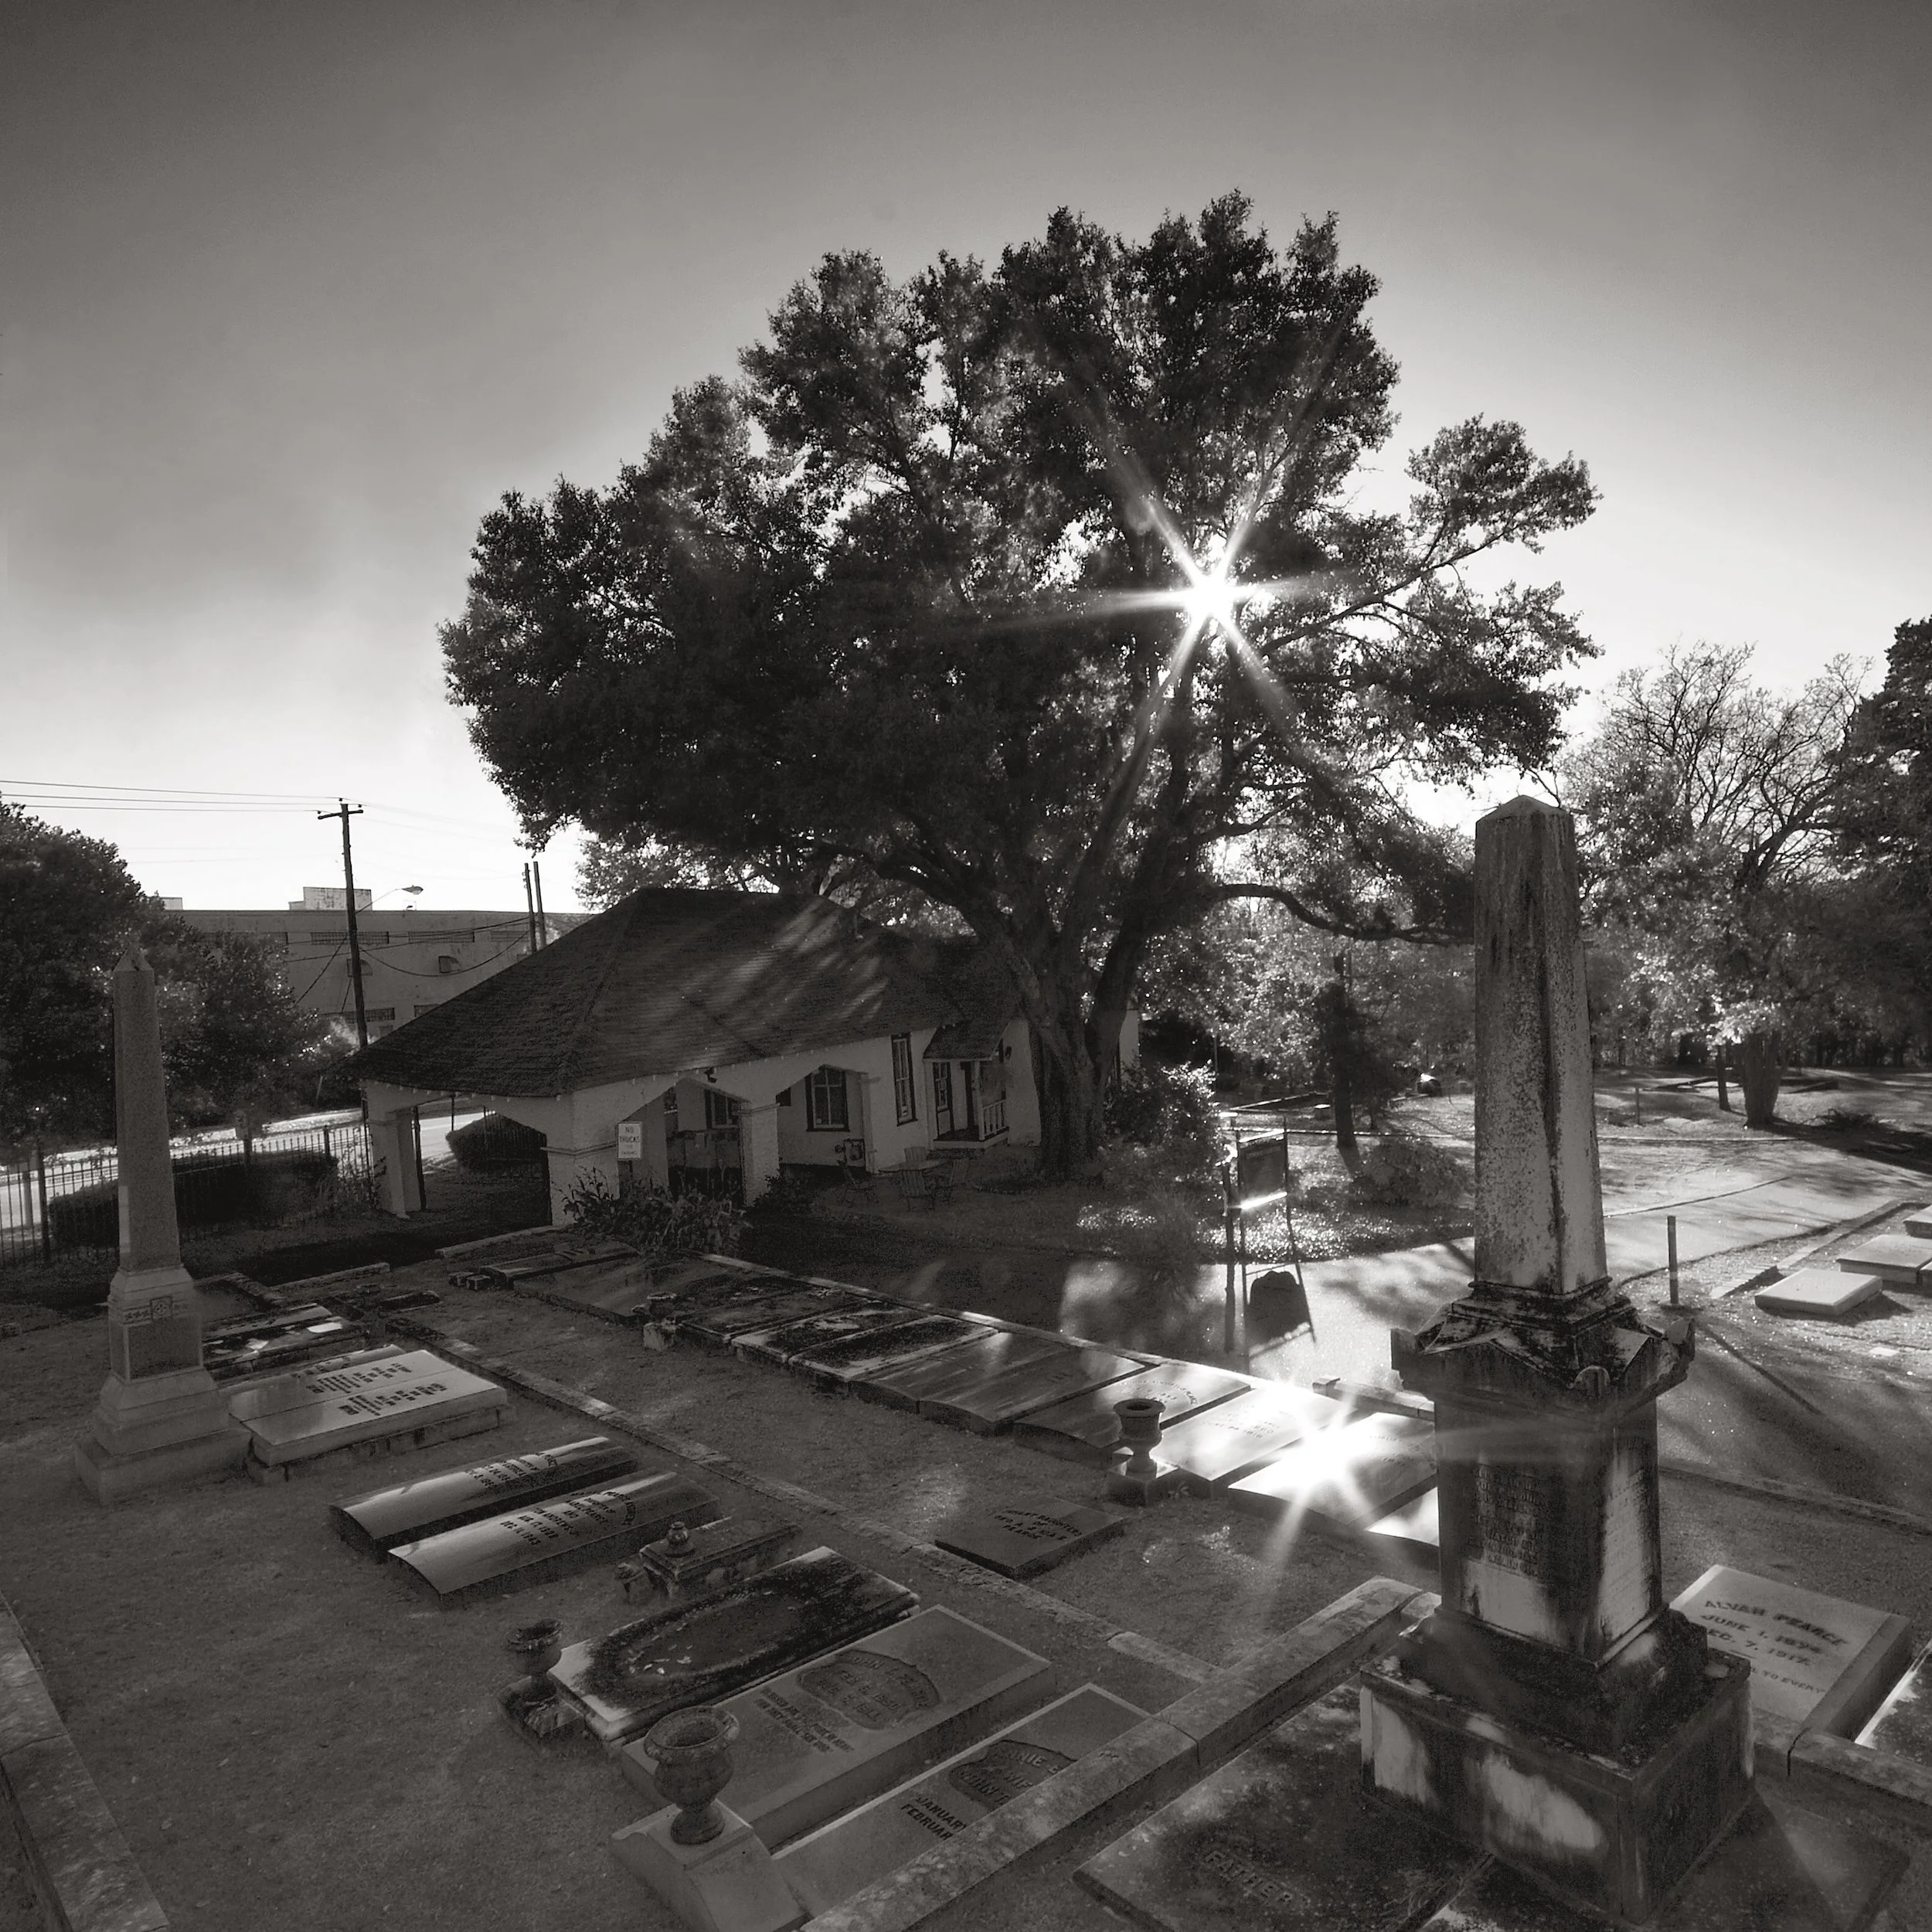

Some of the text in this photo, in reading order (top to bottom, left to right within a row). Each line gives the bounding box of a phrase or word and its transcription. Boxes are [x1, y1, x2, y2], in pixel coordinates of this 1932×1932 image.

[1701, 1614, 1751, 1631] JUNE
[1707, 1628, 1736, 1643] EC.
[901, 1804, 954, 1841] FEBRUAR
